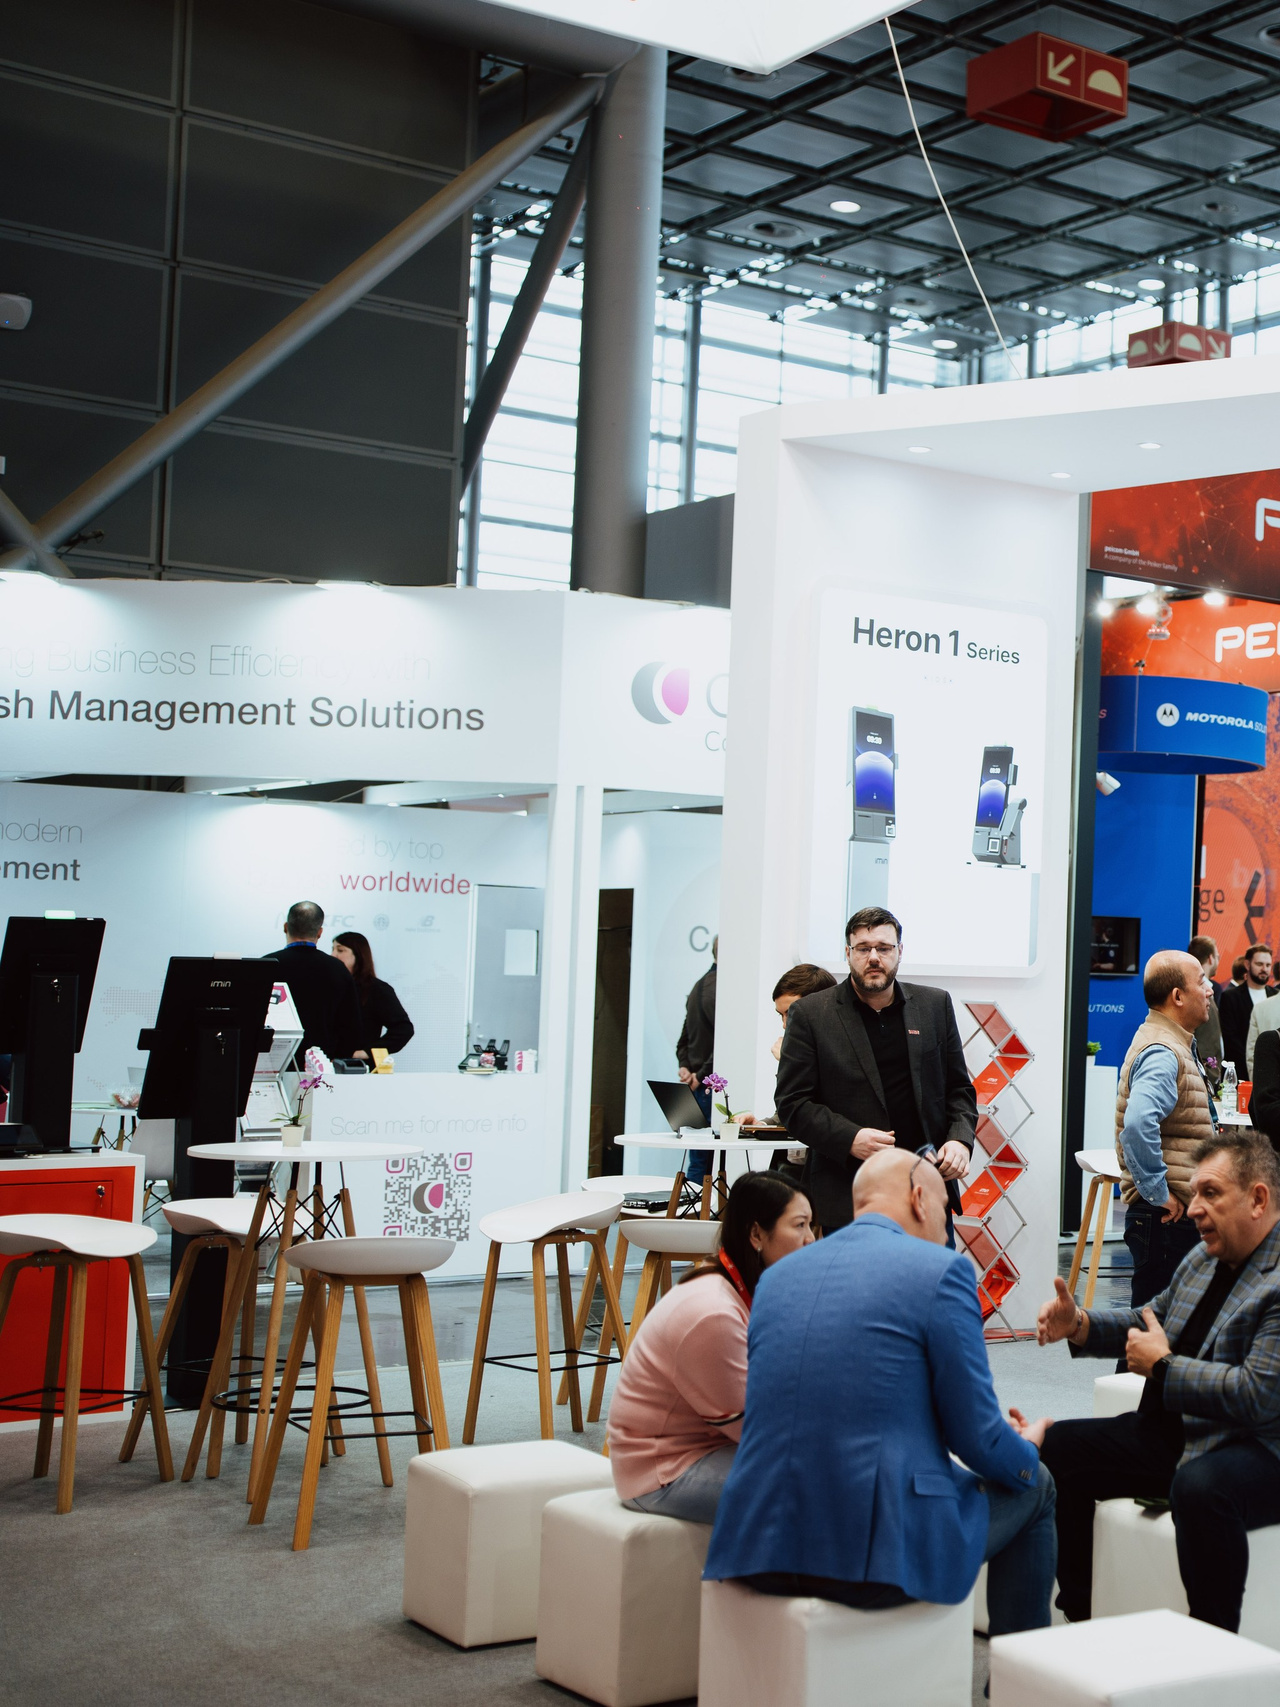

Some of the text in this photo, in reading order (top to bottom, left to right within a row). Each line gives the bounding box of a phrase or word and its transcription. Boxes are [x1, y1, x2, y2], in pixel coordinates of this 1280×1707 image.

[853, 616, 1020, 664] Heron 1 Series
[48, 640, 196, 675] Business
[49, 689, 296, 731] Management
[309, 697, 485, 731] Solutions
[1185, 712, 1254, 730] MOTOROLA
[0, 818, 82, 843] odern
[374, 834, 401, 862] by
[408, 837, 445, 863] top
[0, 859, 80, 881] ment
[340, 870, 471, 896] worldwide
[330, 1114, 527, 1135] Scan me for more info
